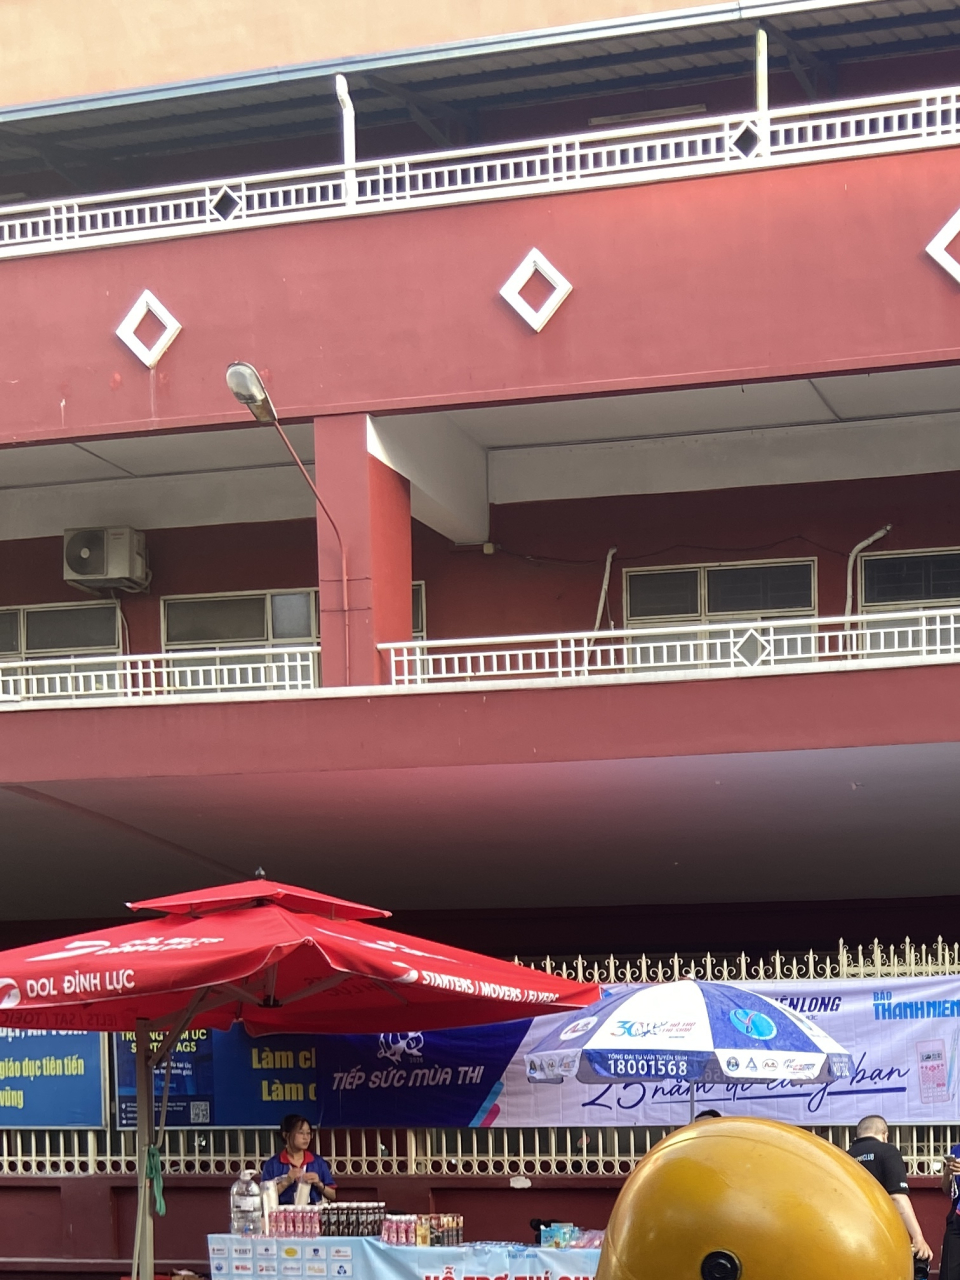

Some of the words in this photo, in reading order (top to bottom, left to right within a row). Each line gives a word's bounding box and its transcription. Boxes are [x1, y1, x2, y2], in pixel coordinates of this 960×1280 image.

[26, 978, 58, 998] DOL
[63, 969, 101, 993] ĐÌNH
[105, 968, 136, 994] LỰC
[422, 971, 474, 993] STARTERS
[481, 983, 522, 1002] MOVERS
[873, 990, 892, 1001] BÁO
[176, 1042, 197, 1053] AGS
[252, 1046, 293, 1069] Làm
[0, 1057, 21, 1080] giáo
[22, 1057, 42, 1082] dục
[42, 1055, 63, 1077] tiên
[64, 1054, 85, 1076] tiến
[332, 1065, 366, 1091] TIẾP
[368, 1067, 407, 1089] SỨC
[408, 1064, 452, 1088] MÙA
[457, 1065, 485, 1085] THI
[608, 1059, 687, 1076] 18001568
[850, 1052, 911, 1086] bạn
[261, 1079, 304, 1102] Làm
